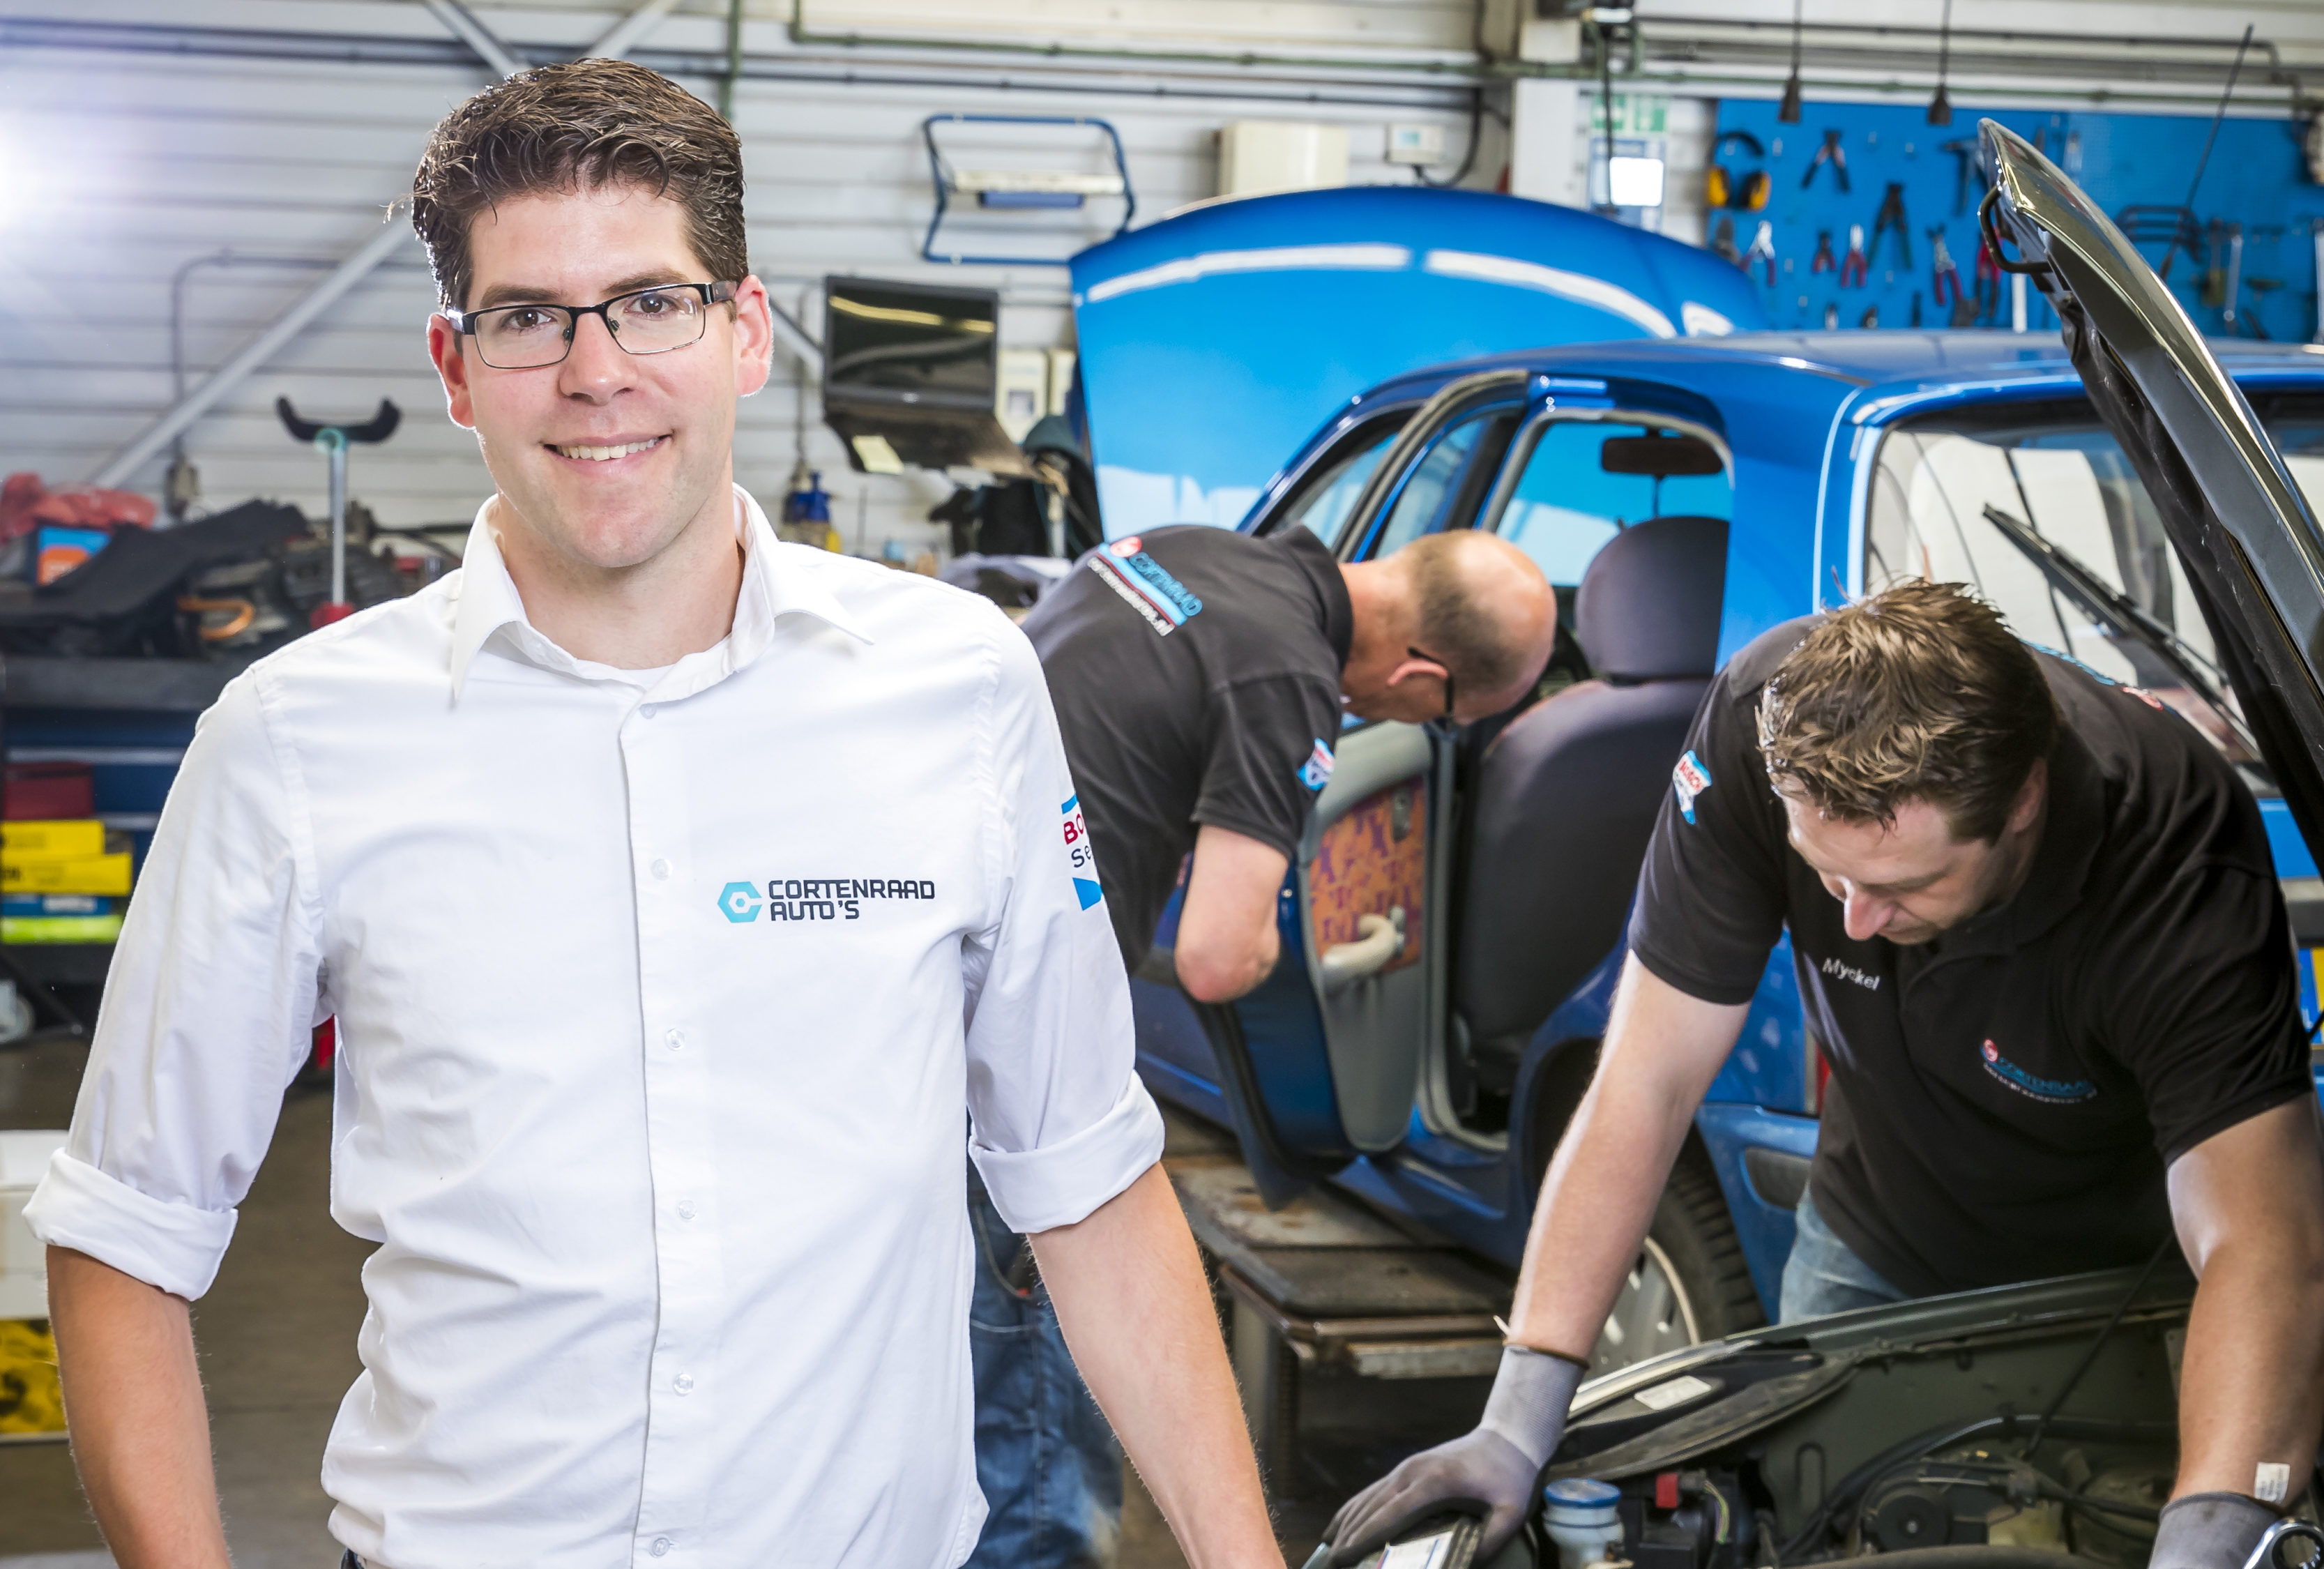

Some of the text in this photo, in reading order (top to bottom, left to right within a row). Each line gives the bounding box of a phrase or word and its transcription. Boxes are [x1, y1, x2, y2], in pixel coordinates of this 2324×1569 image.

[768, 879, 935, 900] CORTENRAAD
[770, 900, 860, 921] AUTO'S
[1822, 957, 1881, 990] Myckel
